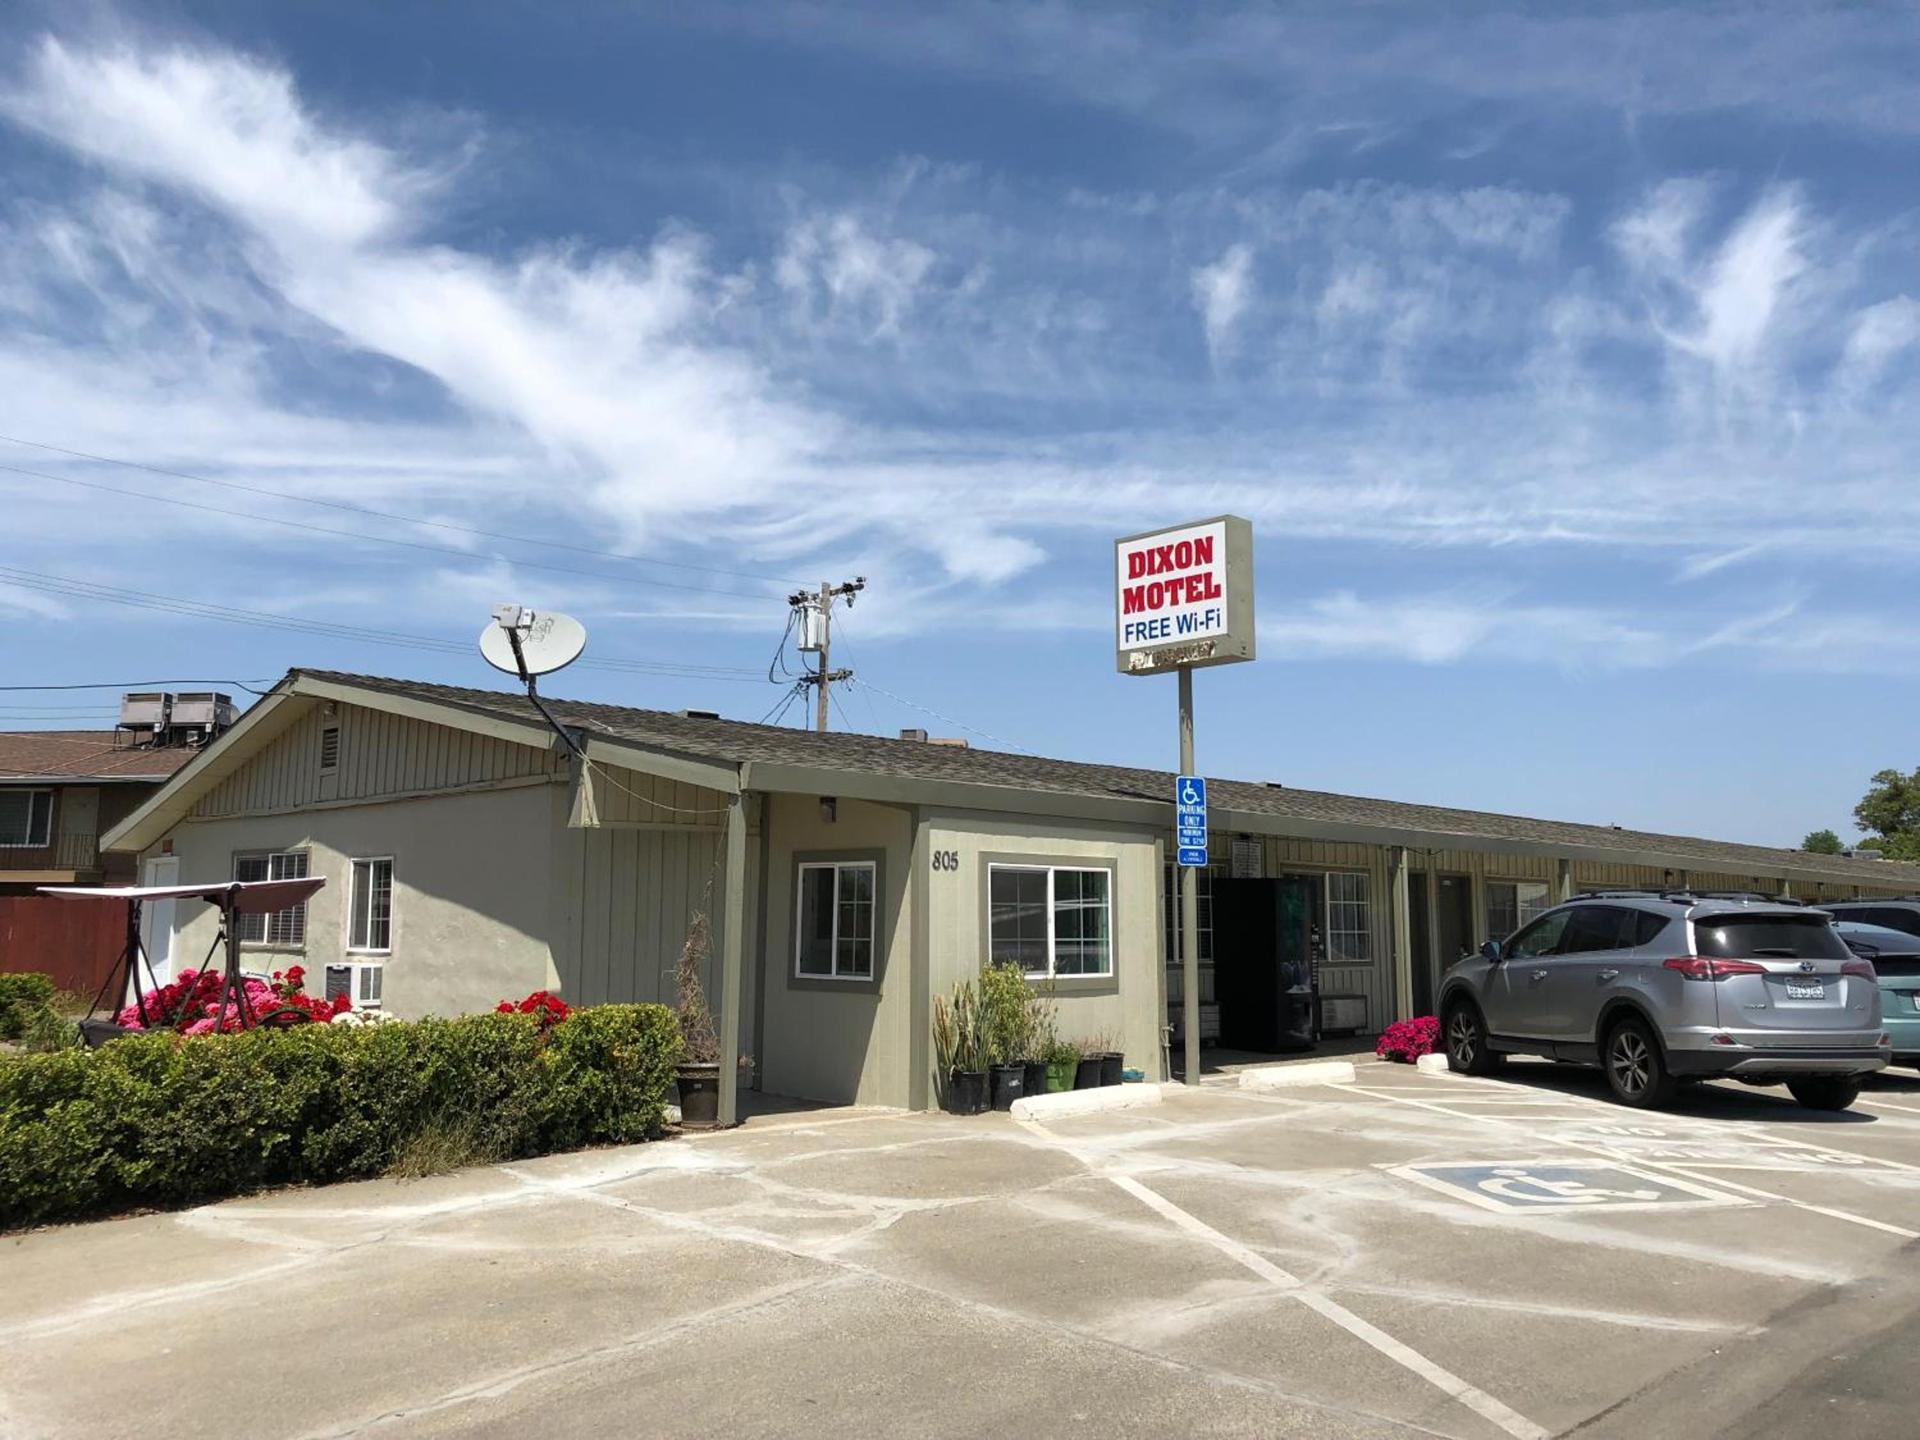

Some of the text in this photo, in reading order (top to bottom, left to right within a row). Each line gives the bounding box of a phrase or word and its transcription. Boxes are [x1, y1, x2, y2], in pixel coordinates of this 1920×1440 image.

[1128, 536, 1214, 580] DIXON
[1123, 572, 1222, 615] MOTEL
[1125, 608, 1221, 643] FREE Wi-Fi
[1179, 804, 1205, 815] PARKING
[1184, 815, 1200, 826] ONLY
[932, 850, 959, 871] 805
[1590, 1125, 1667, 1137] NO
